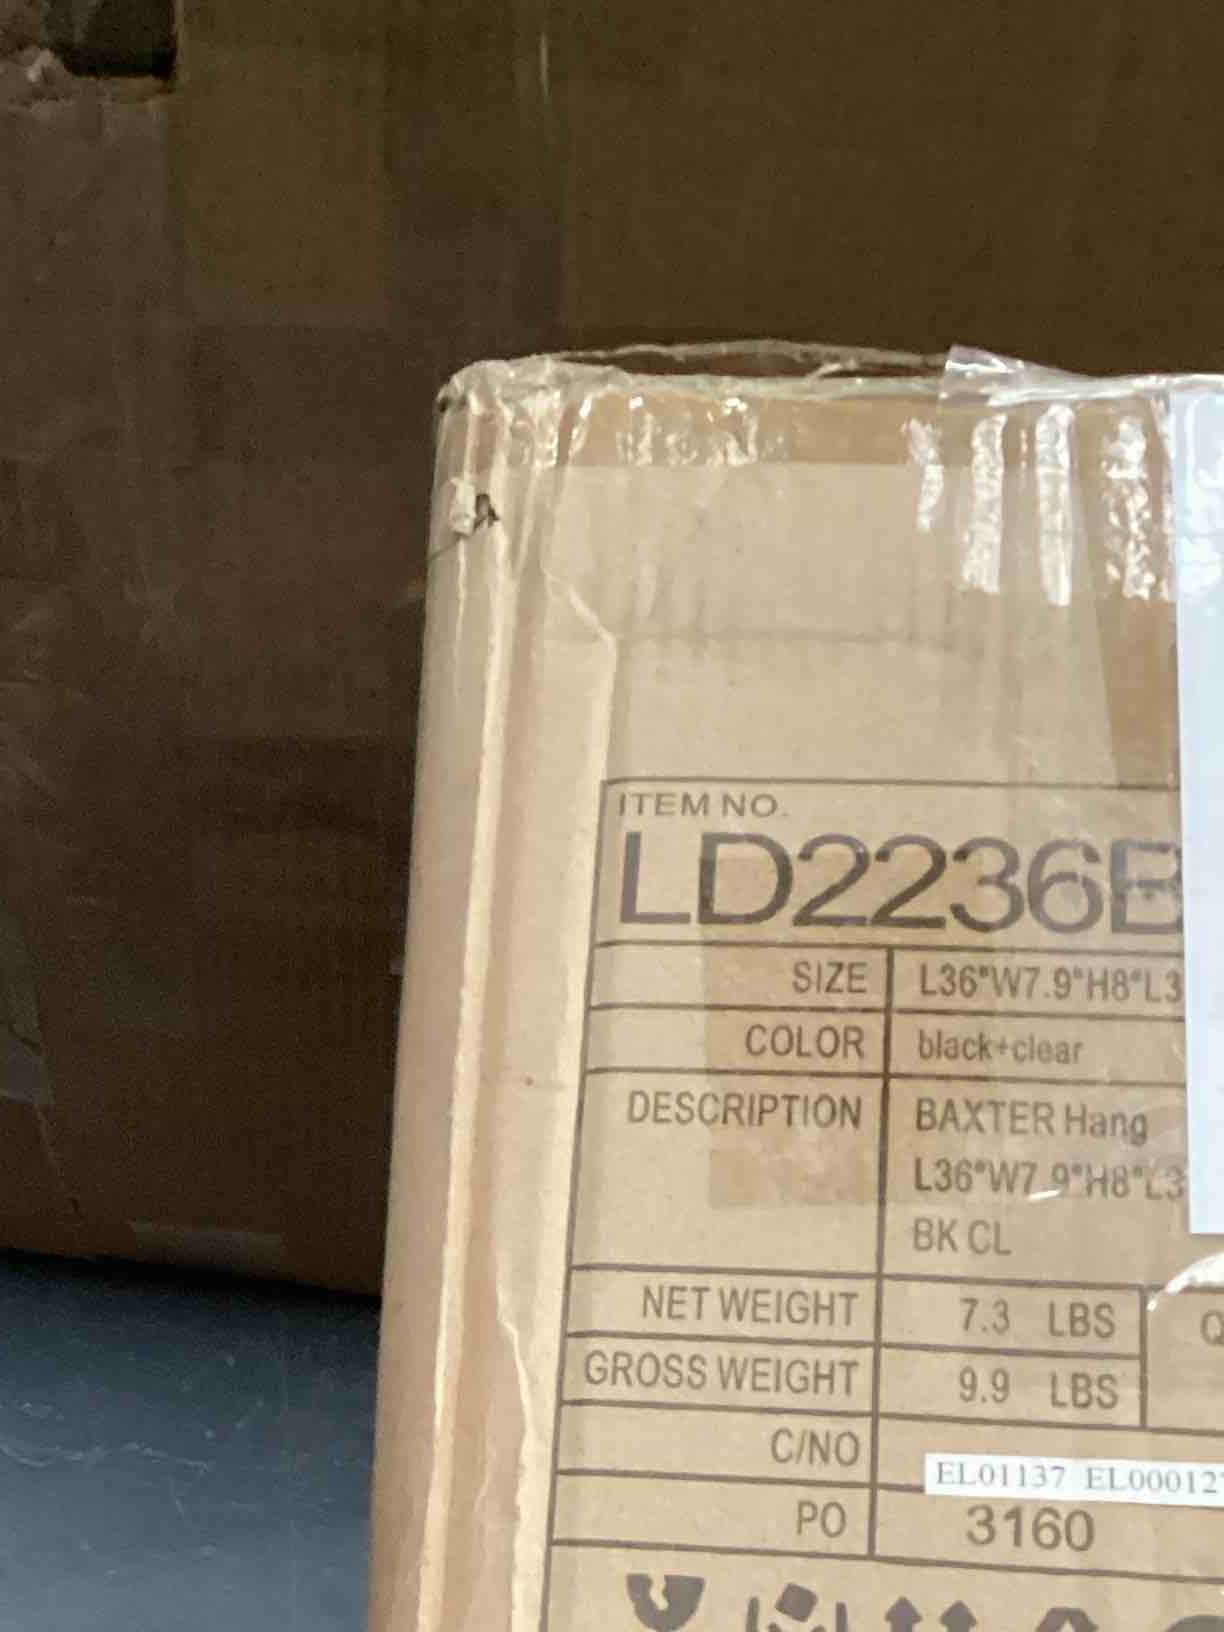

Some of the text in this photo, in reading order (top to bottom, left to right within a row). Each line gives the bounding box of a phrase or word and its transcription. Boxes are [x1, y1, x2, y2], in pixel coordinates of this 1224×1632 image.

[618, 792, 711, 817] ITEM
[792, 961, 868, 994] SIZE
[745, 1023, 866, 1060] COLOR
[918, 1028, 1084, 1065] black+clear
[627, 1089, 863, 1129] DESCRIPTION
[915, 1096, 1149, 1147] BAXTER Hang
[911, 1217, 1013, 1256] BK CL
[642, 1285, 859, 1327] NET WEIGHT
[959, 1297, 1116, 1338] 7.3 LBS
[584, 1350, 860, 1397] GROSS WEIGHT
[959, 1366, 1119, 1410] 9.9 LBS
[770, 1427, 860, 1467] C/NO
[936, 1461, 1224, 1494] EL01137 EL00012
[796, 1500, 847, 1538] PO
[966, 1504, 1096, 1552] 3160
